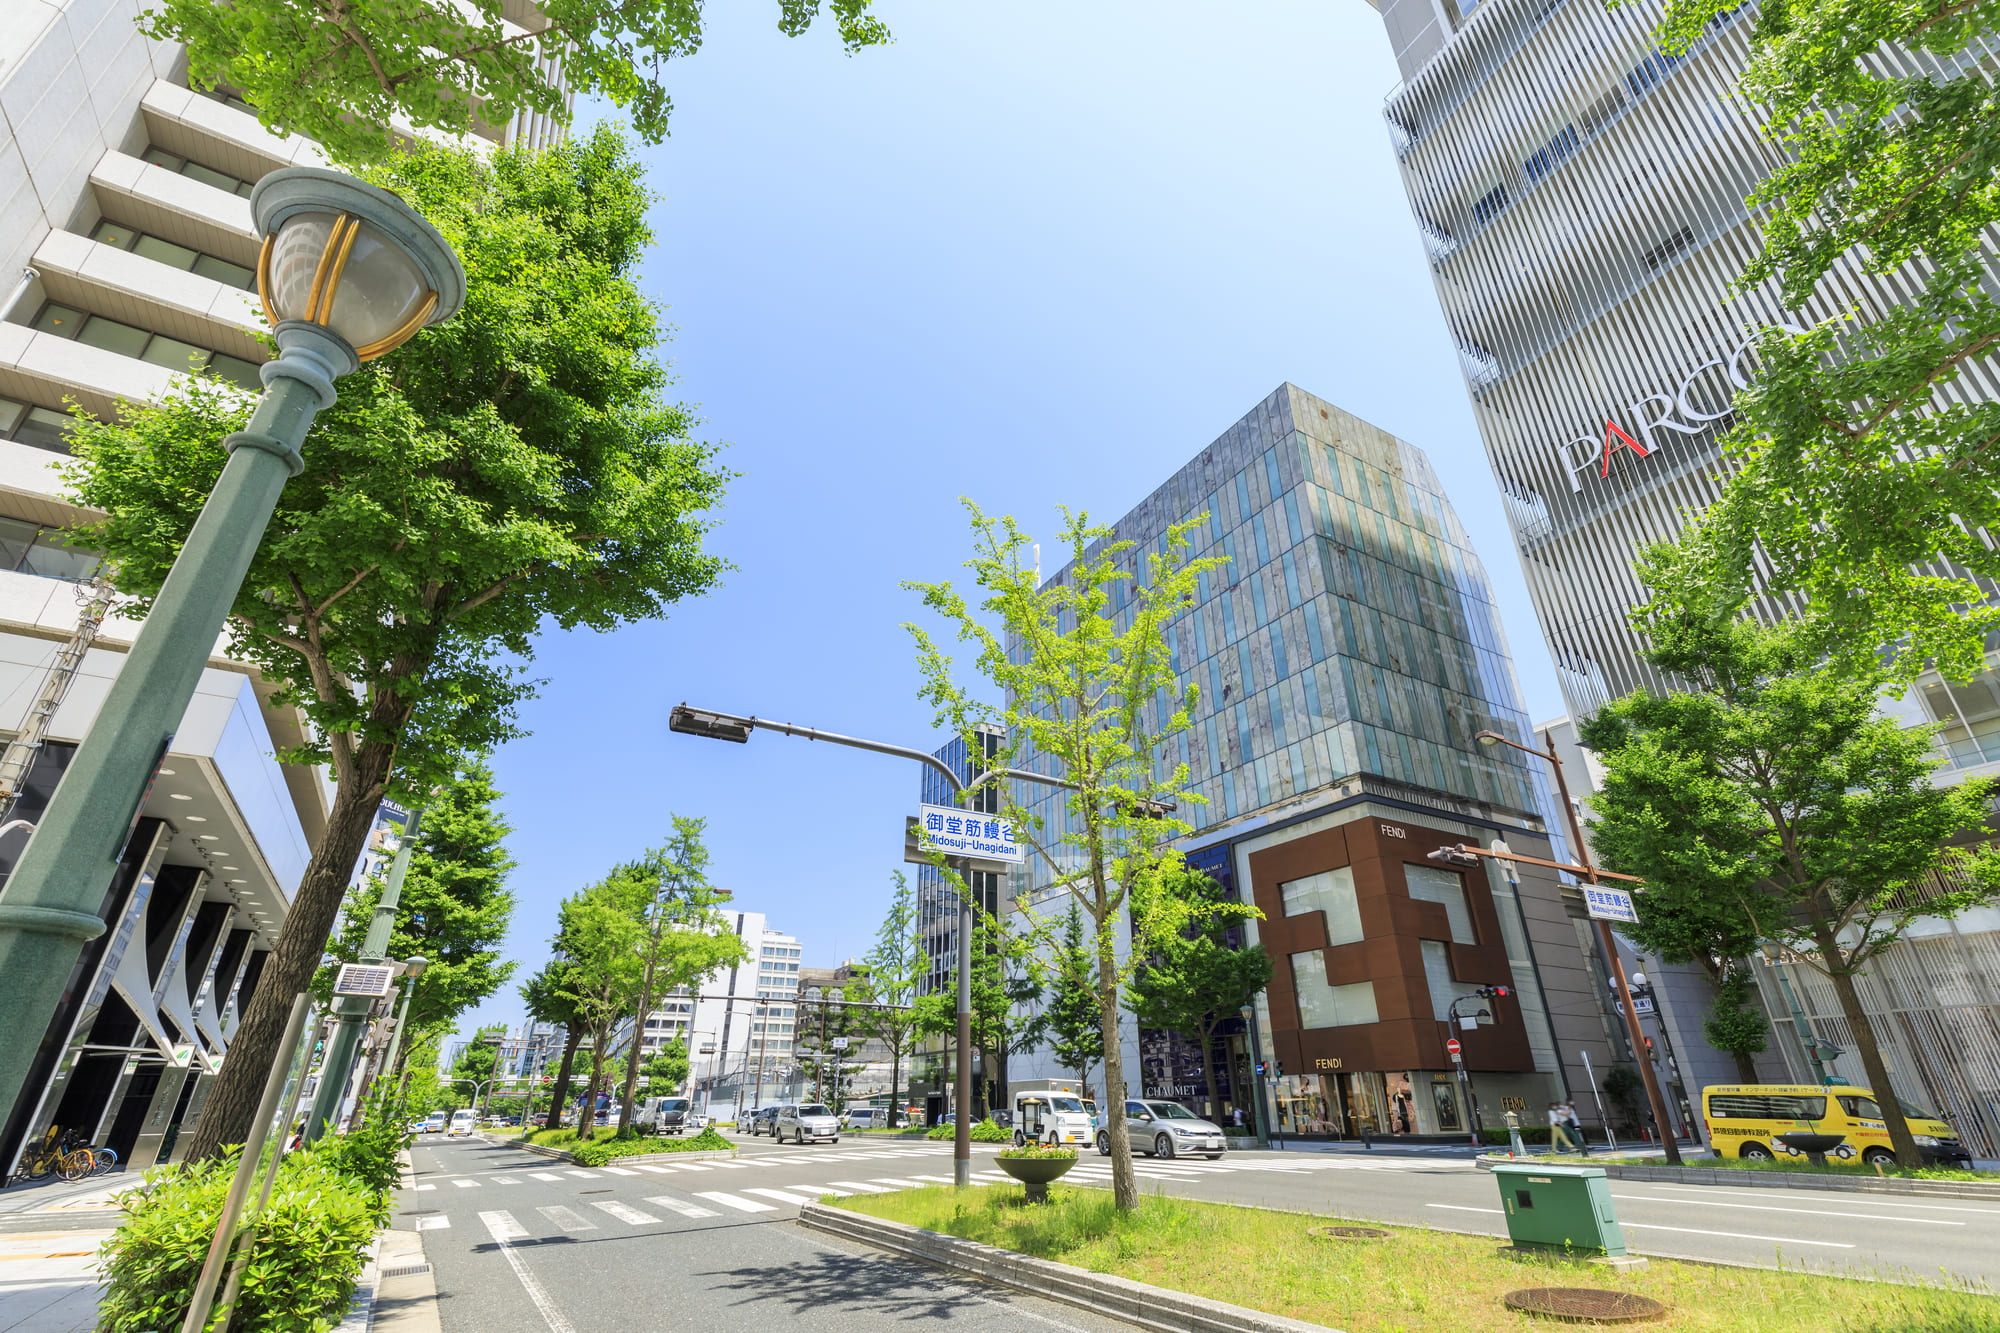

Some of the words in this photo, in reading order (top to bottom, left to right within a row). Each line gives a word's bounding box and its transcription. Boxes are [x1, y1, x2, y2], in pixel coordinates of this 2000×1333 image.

[926, 813, 1016, 842] 御堂筋鰻谷
[1381, 825, 1407, 839] FENDI
[928, 834, 1017, 855] Midosuji-Unagidani
[1316, 1058, 1342, 1069] FENDI
[1146, 1085, 1197, 1097] CHAUMET
[1501, 1096, 1526, 1111] FENDI
